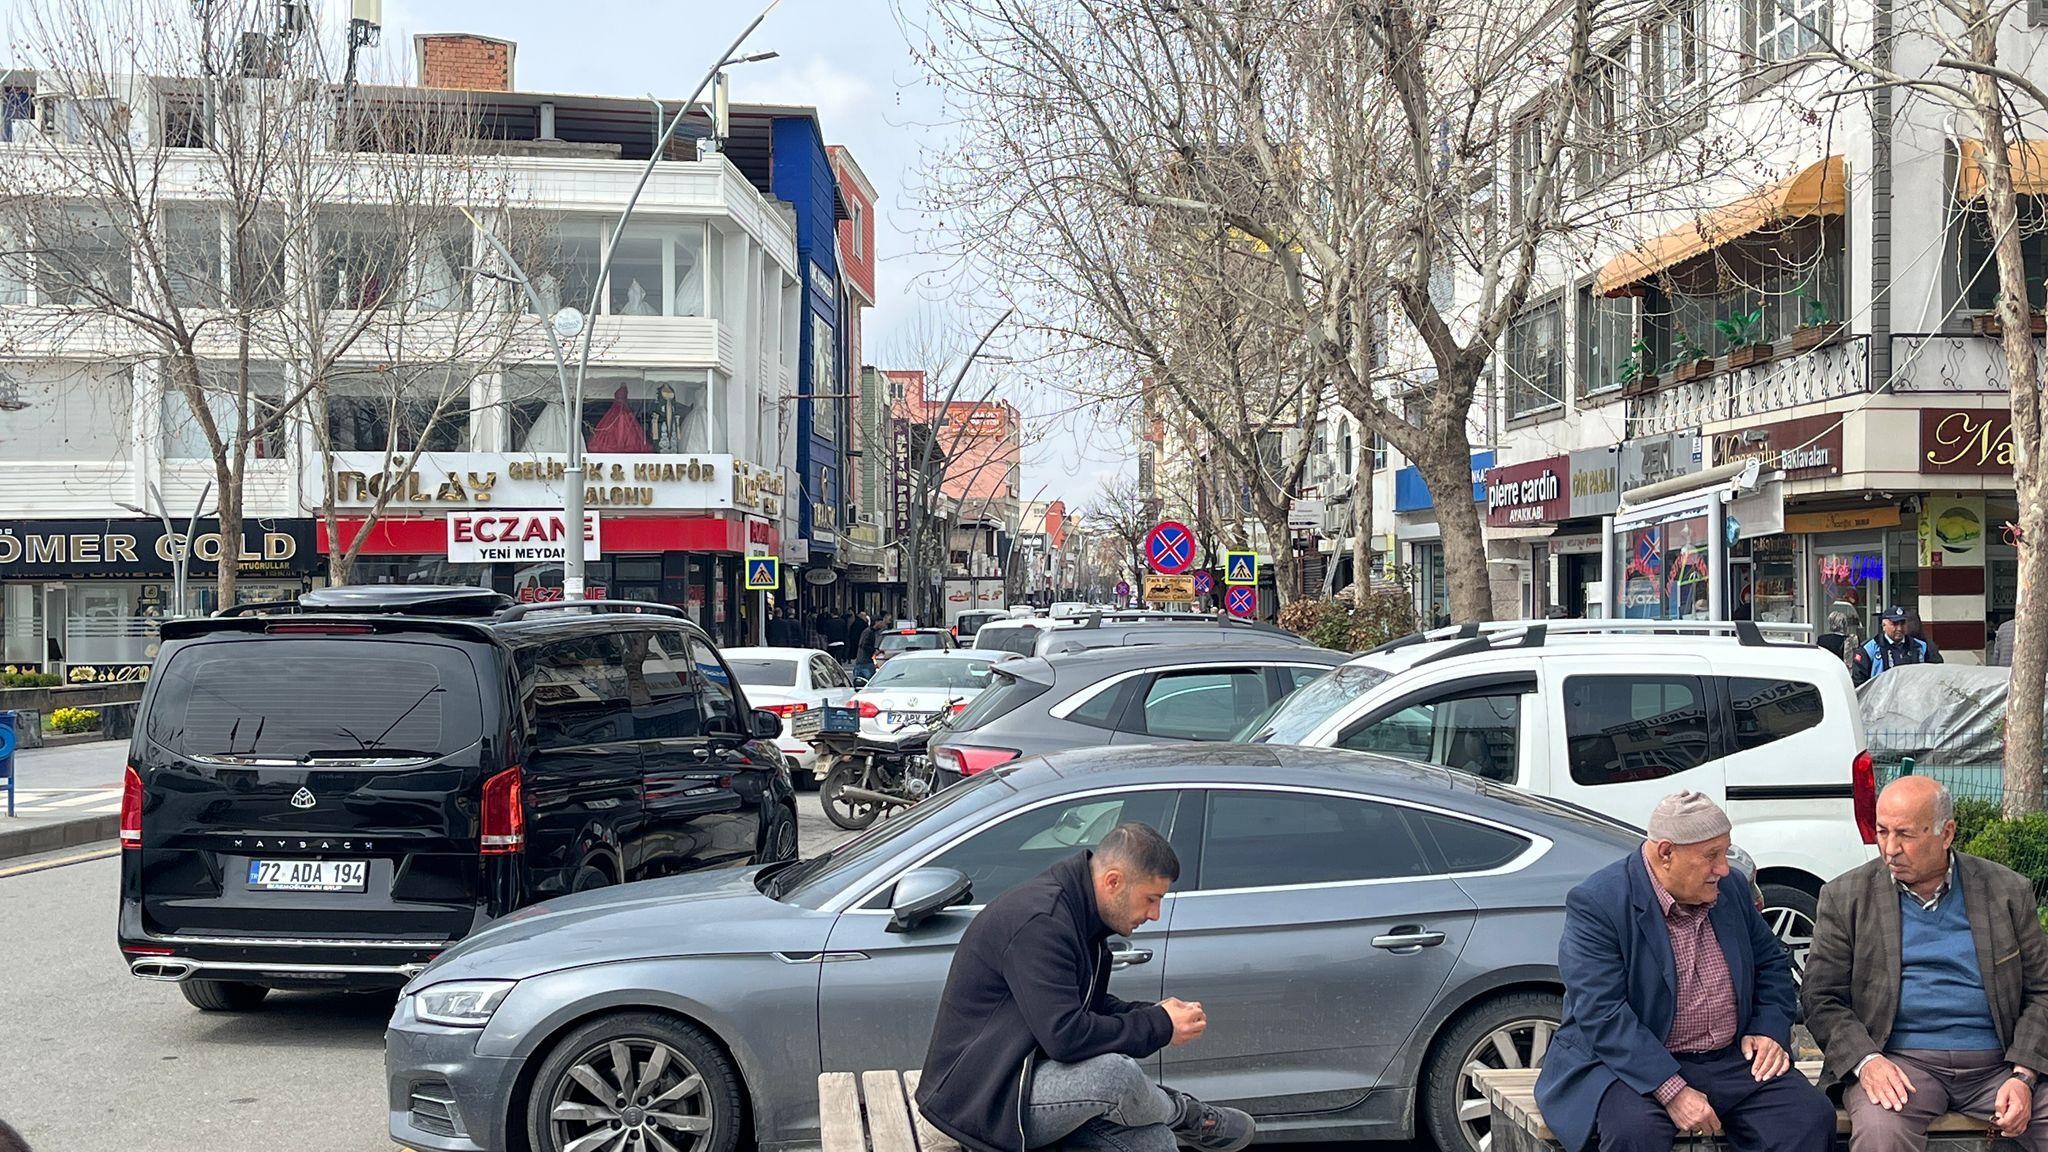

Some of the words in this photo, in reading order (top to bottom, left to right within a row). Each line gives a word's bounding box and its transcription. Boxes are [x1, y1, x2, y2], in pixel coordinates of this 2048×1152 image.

[1781, 445, 1829, 470] Baklavaları
[508, 457, 603, 481] GELİNİK
[610, 463, 625, 481] &
[634, 458, 715, 482] KUAFÖR
[585, 486, 653, 506] ALONU
[1488, 478, 1519, 514] pierre
[1521, 469, 1558, 505] cardin
[1509, 506, 1544, 523] AYAKKABI
[454, 517, 594, 543] ECZANE
[0, 528, 139, 563] ÖMER
[155, 533, 296, 562] GOLD
[479, 546, 511, 559] YENİ
[238, 561, 290, 570] RTUĞRULLAR
[520, 586, 607, 603] ECZNE
[891, 714, 902, 723] 72
[234, 840, 373, 850] MAYBACH
[260, 863, 280, 882] 72
[290, 863, 322, 883] ADA
[334, 864, 362, 883] 194
